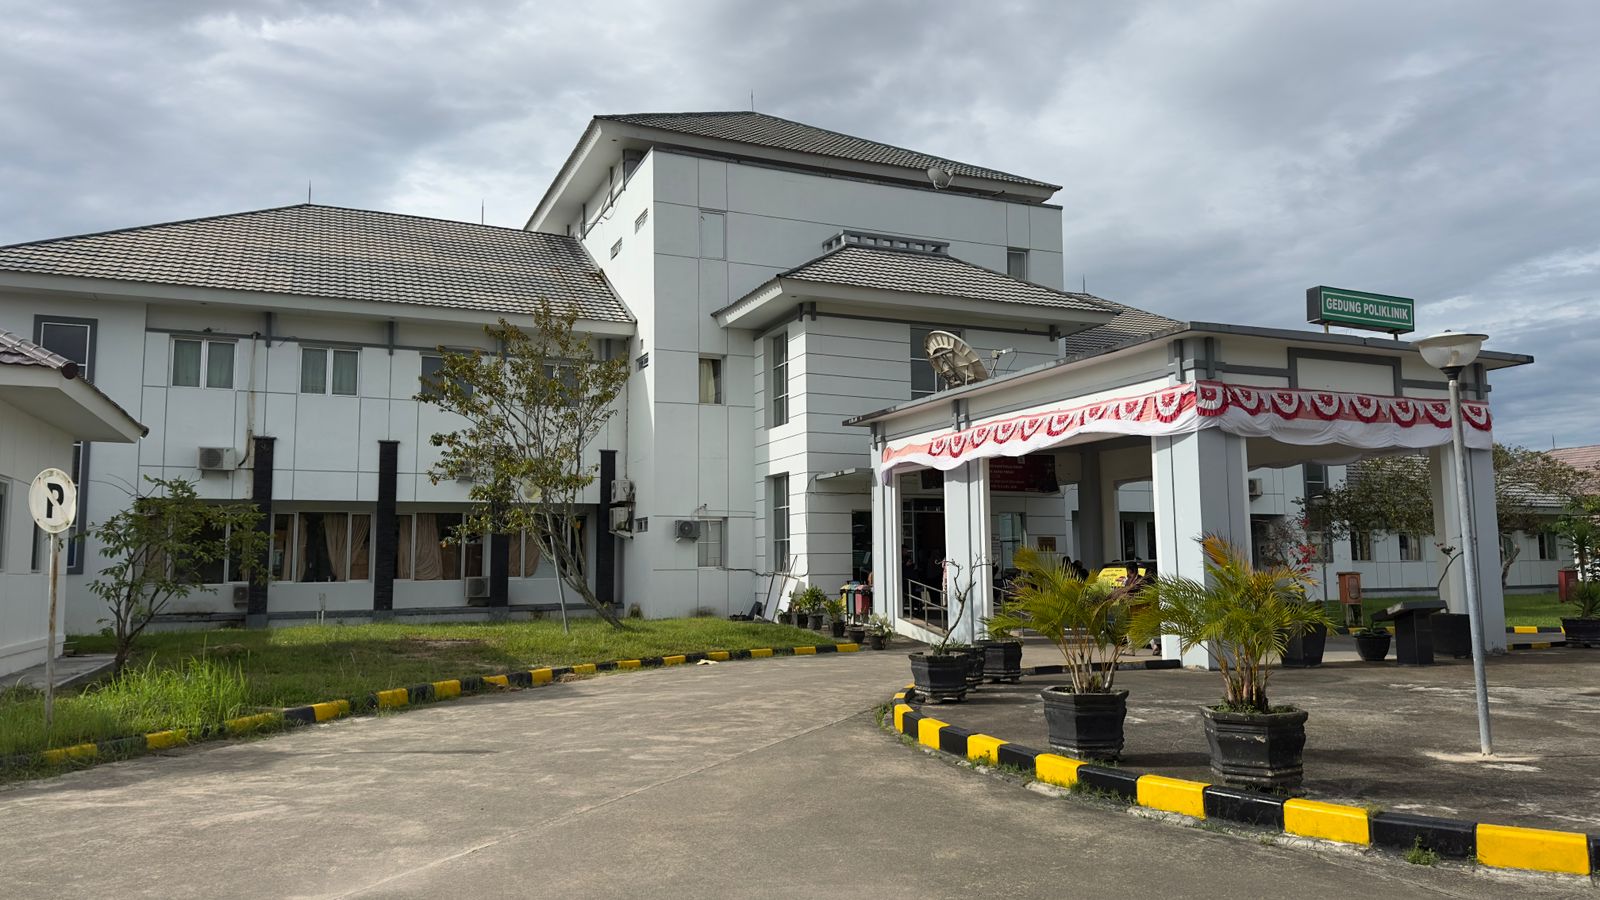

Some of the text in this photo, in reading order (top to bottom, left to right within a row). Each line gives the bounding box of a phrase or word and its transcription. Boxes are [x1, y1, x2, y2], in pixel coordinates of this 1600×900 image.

[1326, 297, 1408, 320] GEDUNG POLIKLINIK
[46, 482, 64, 519] P
